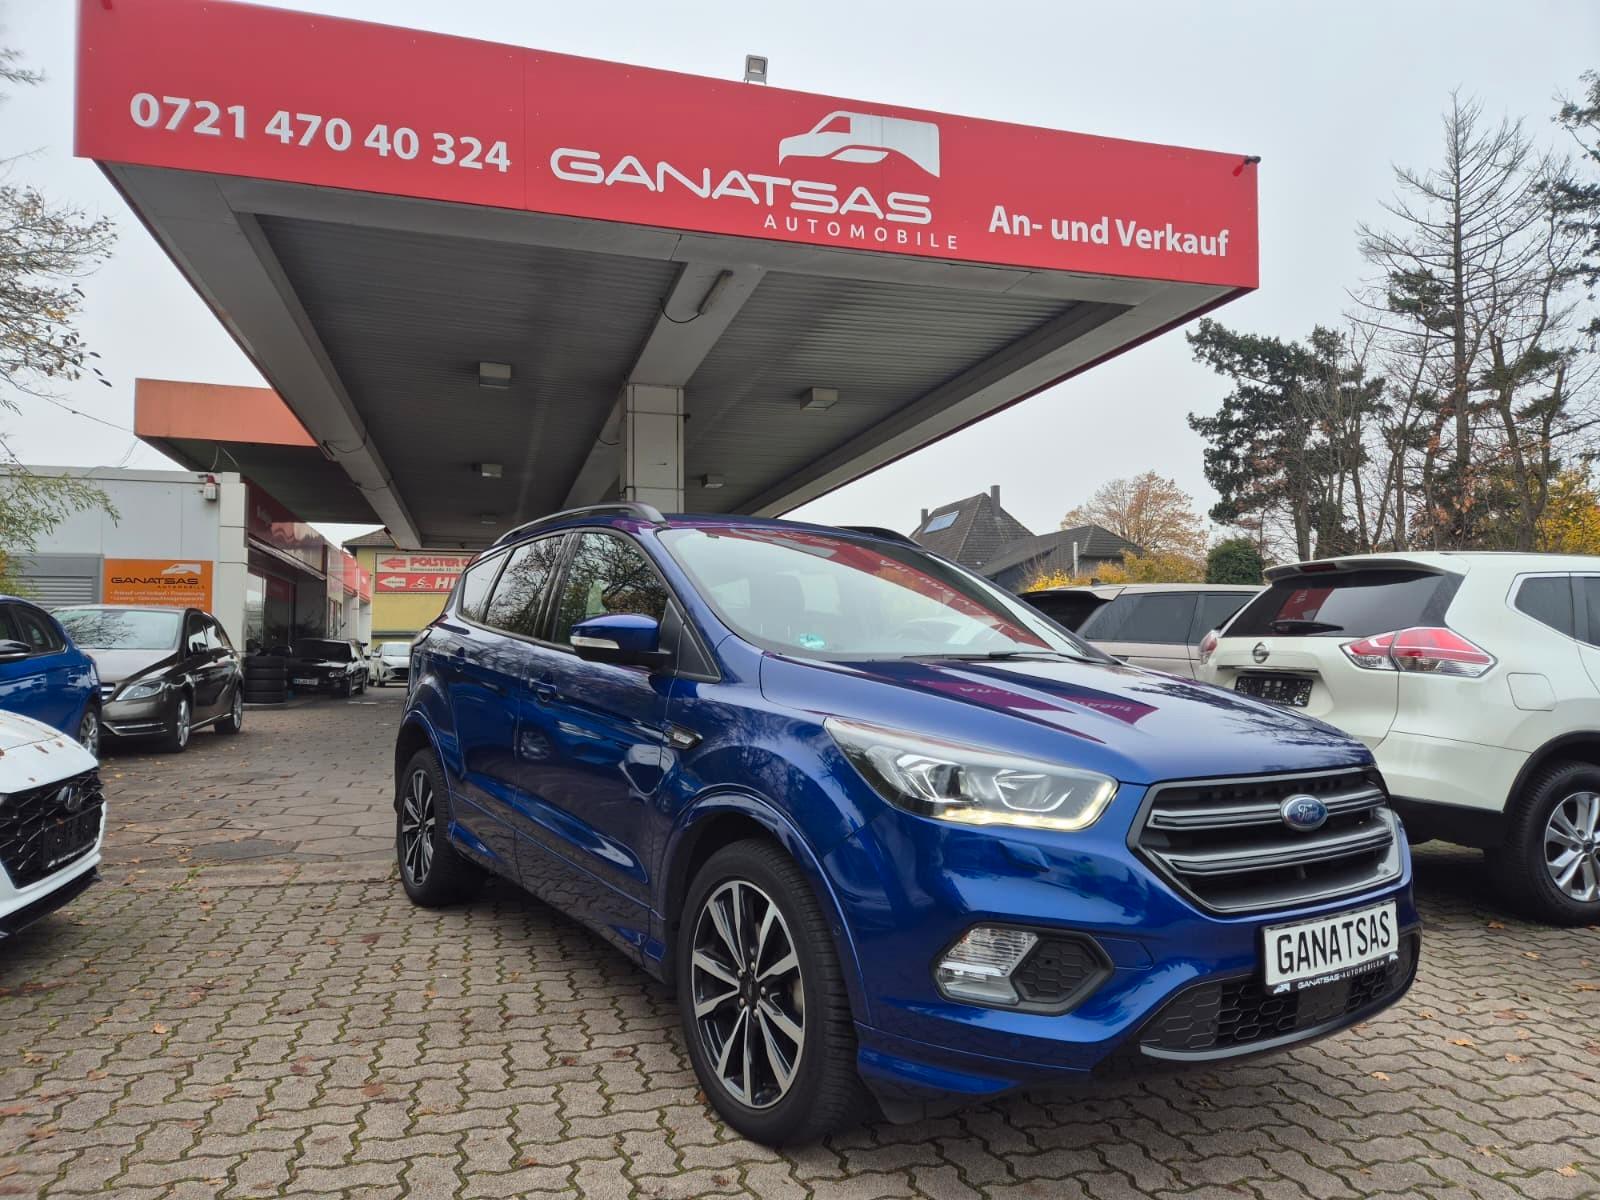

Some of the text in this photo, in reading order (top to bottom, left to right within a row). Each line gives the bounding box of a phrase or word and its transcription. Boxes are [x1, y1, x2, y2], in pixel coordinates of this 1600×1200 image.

[130, 92, 511, 173] 0721 470 40 324
[550, 147, 932, 225] GANATSAS
[764, 214, 959, 250] AUTOMOBILE
[988, 205, 1230, 257] An- und Verkauf
[111, 577, 199, 585] GANATSAS
[1276, 910, 1391, 975] GANATSAS
